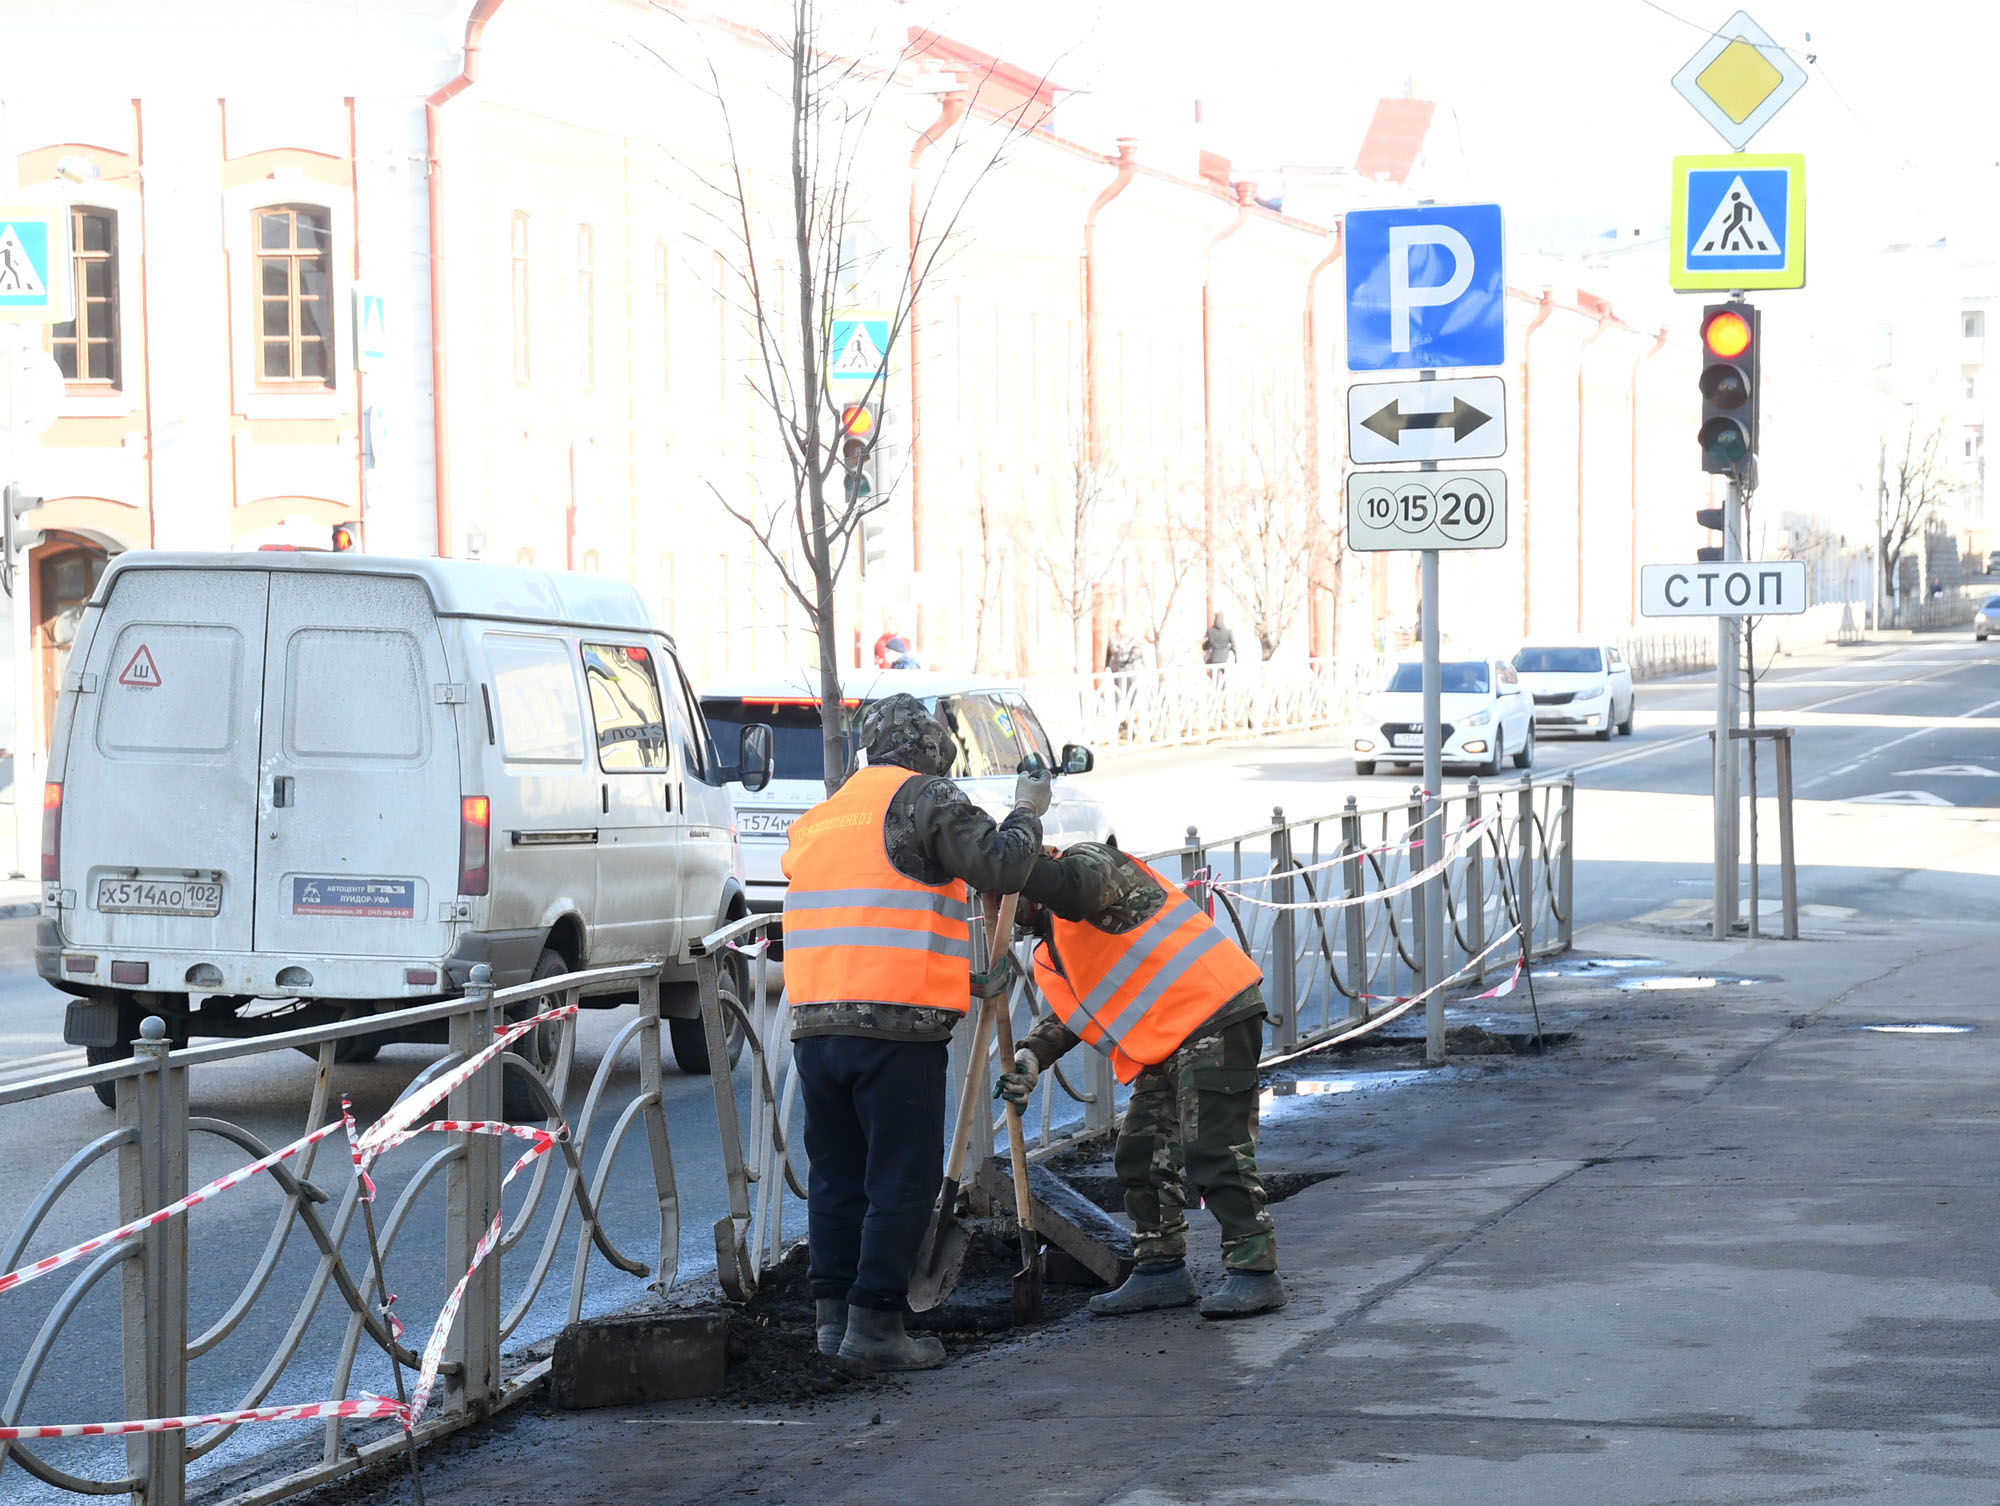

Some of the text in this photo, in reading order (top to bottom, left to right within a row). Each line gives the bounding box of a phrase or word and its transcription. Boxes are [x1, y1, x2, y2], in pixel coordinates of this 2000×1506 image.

[1389, 224, 1475, 353] P
[1367, 492, 1486, 526] 10 15 20
[1664, 571, 1782, 608] СТОП
[133, 664, 149, 678] Ш
[743, 814, 793, 832] Т574М
[187, 886, 216, 902] 102
[327, 885, 366, 894] АВТОЦЕНТР
[340, 895, 391, 904] ЛУИДОР-УФА
